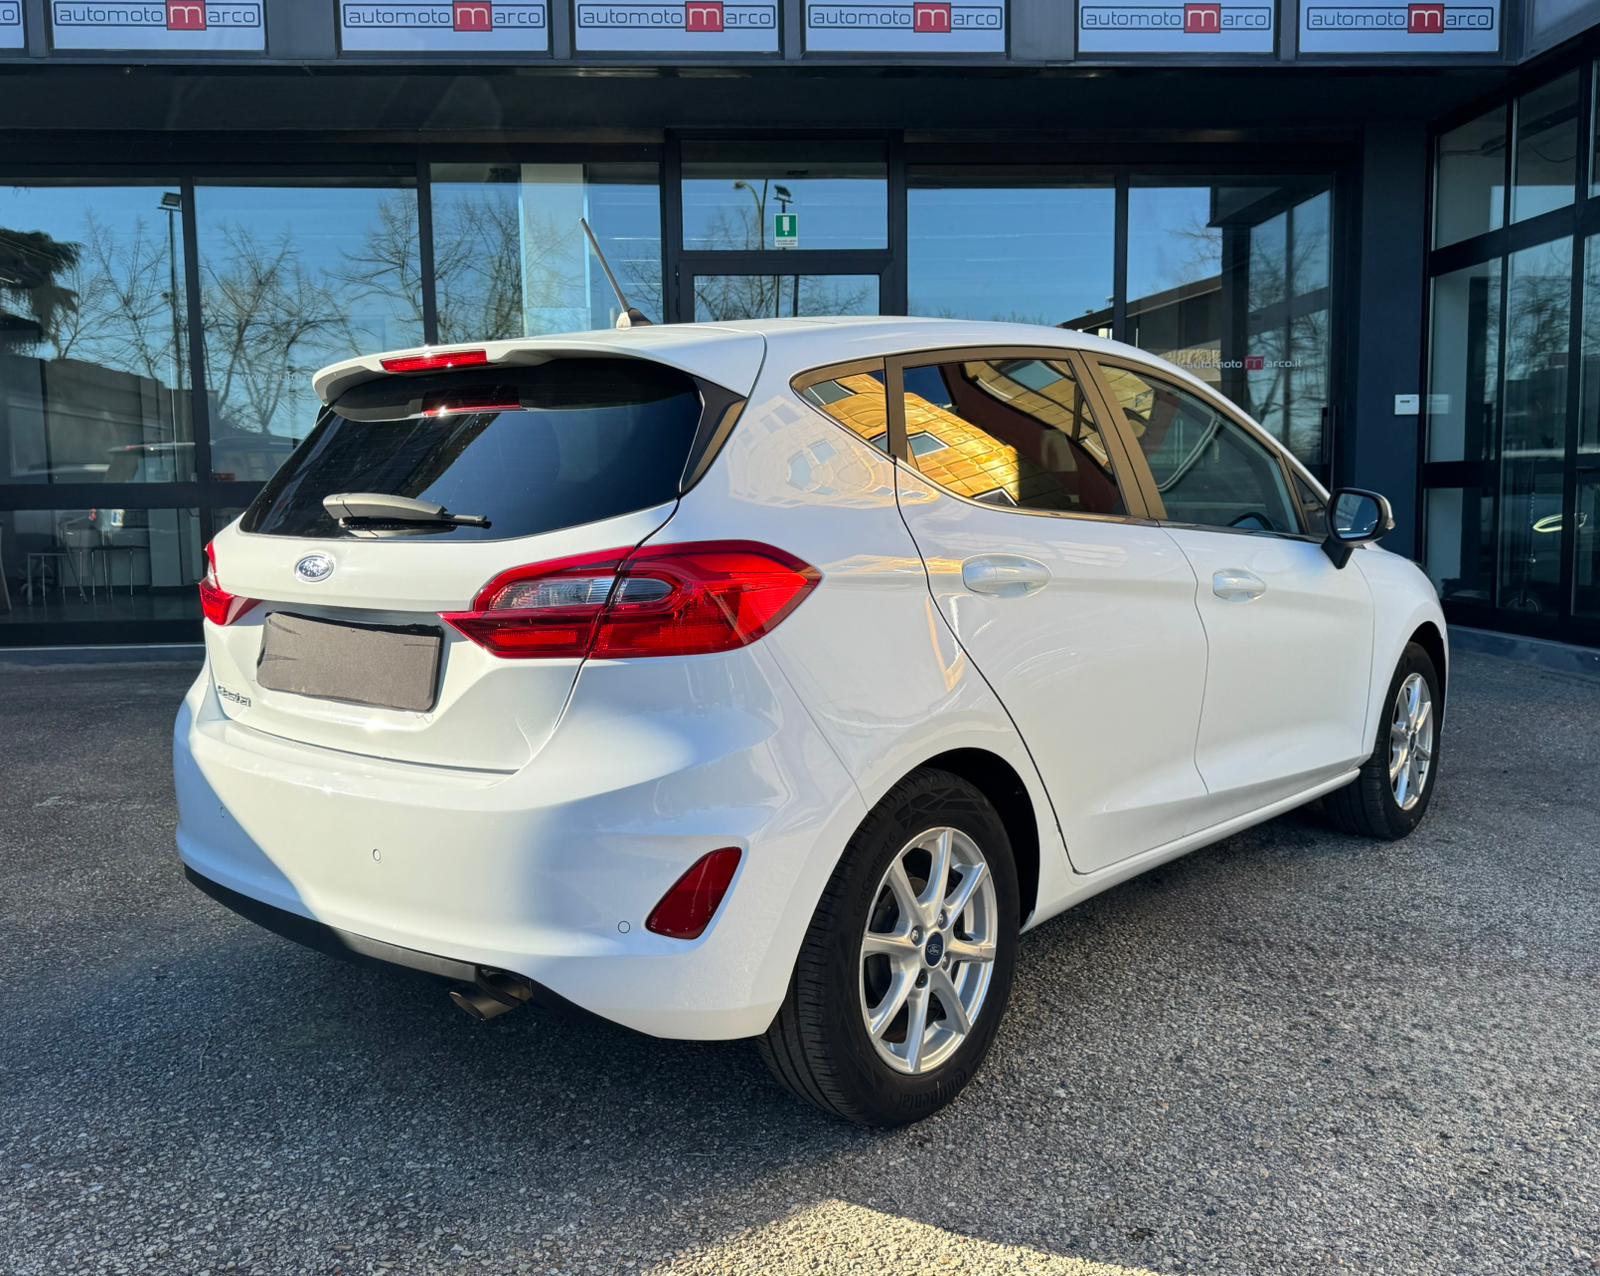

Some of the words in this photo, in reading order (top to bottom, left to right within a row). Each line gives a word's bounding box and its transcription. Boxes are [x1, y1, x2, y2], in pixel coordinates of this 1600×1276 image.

[59, 6, 164, 23] automoto
[349, 8, 451, 24] automoto
[583, 8, 683, 24] automoto
[813, 9, 911, 25] automoto
[1085, 11, 1181, 26] automoto
[1311, 11, 1406, 27] automoto
